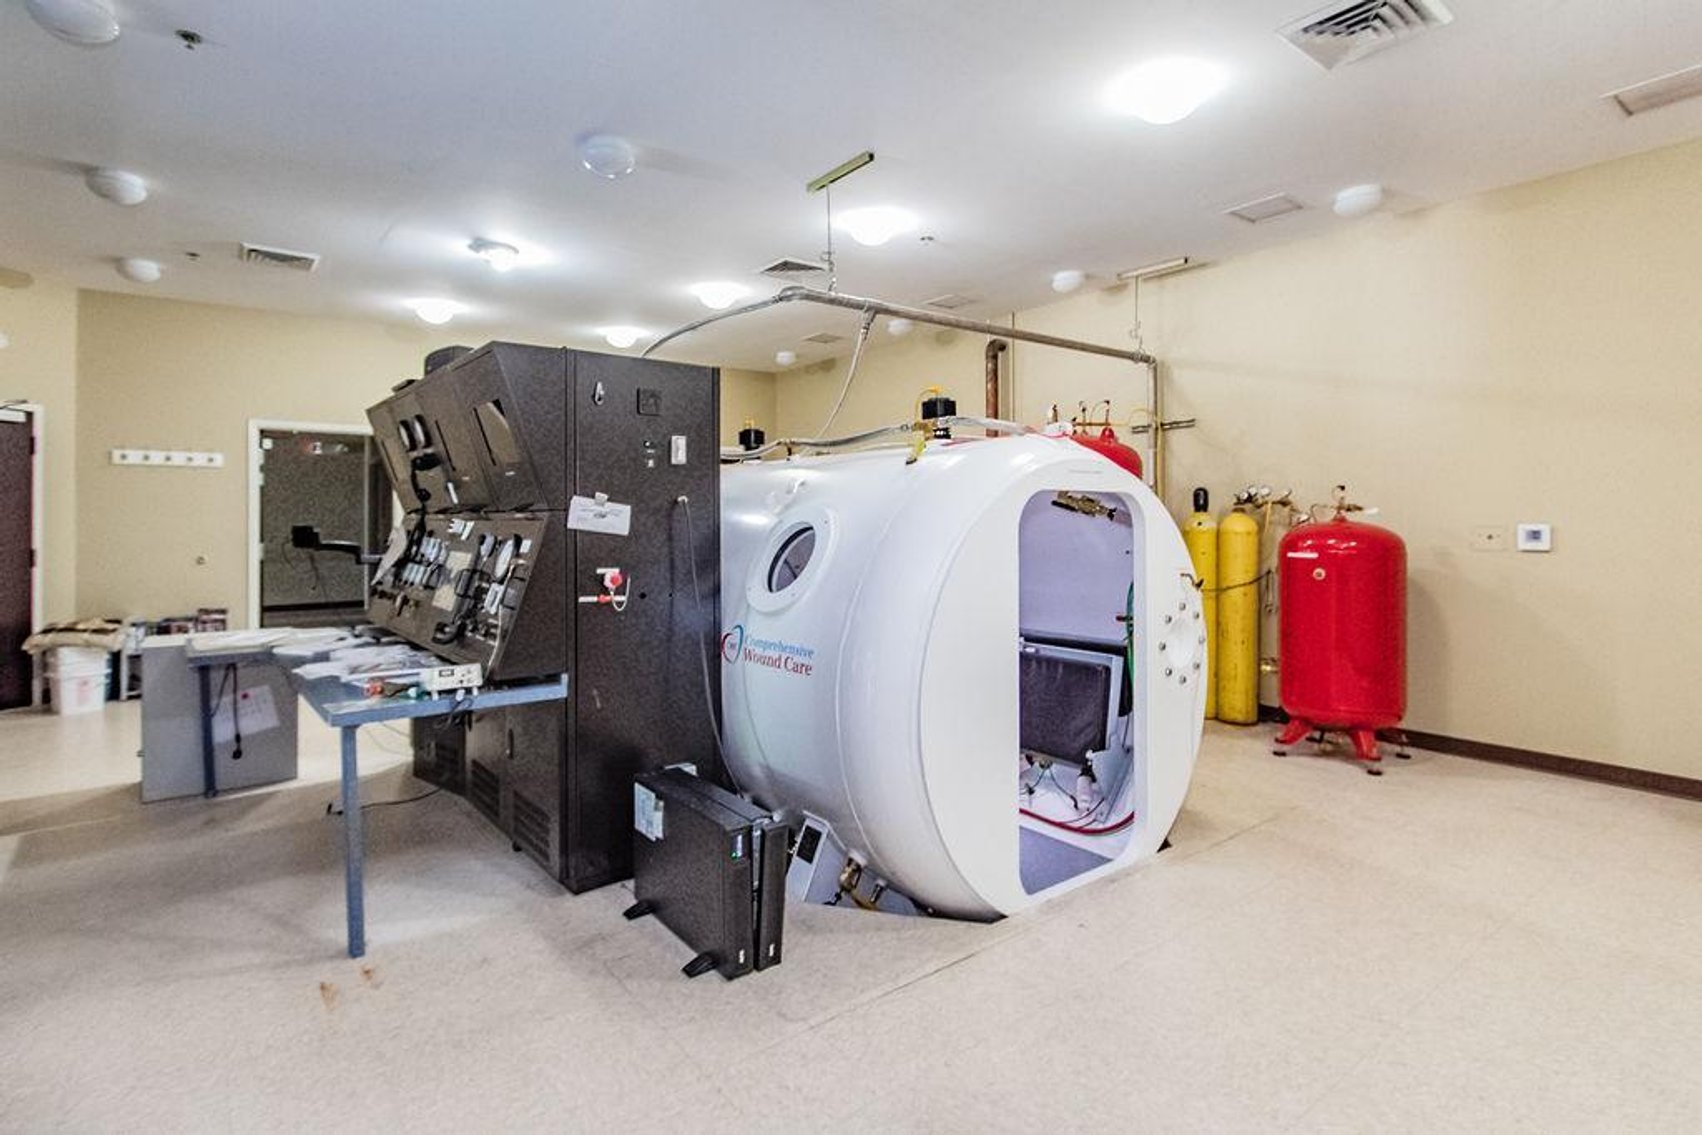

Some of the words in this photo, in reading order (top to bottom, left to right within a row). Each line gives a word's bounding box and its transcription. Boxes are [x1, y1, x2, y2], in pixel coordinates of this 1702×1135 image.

[745, 635, 815, 659] Comprehensive
[744, 648, 782, 669] Wound
[784, 656, 813, 676] Care
